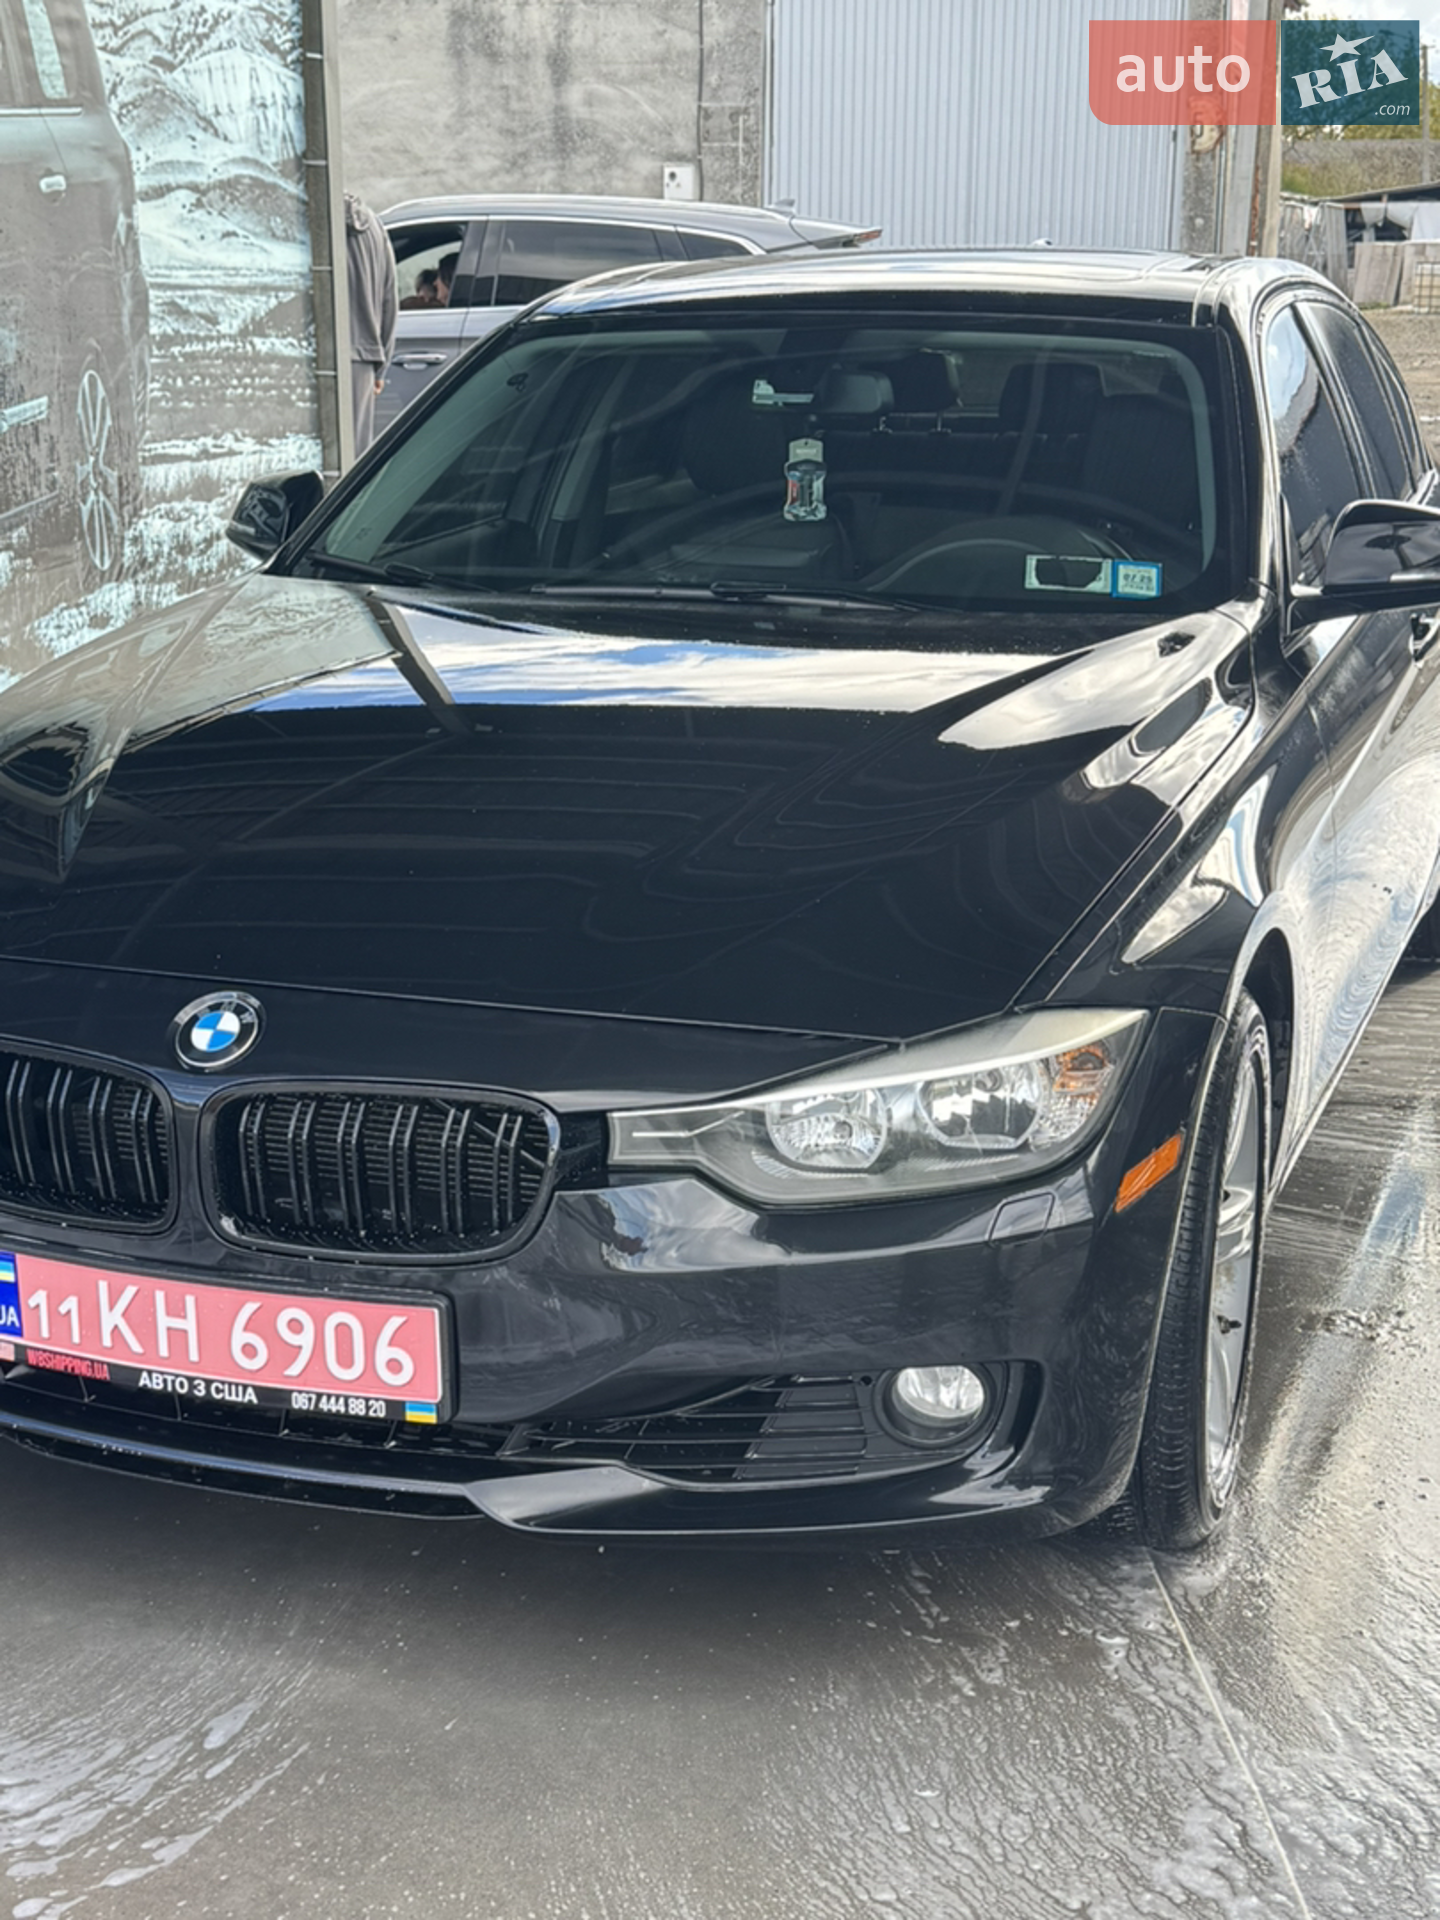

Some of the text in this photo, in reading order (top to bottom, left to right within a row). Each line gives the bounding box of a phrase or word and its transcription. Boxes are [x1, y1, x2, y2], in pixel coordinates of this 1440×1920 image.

[230, 1301, 416, 1388] 6906
[138, 1370, 189, 1395] АВТО
[210, 1381, 259, 1405] США
[291, 1391, 387, 1418] 067 444 88 20
